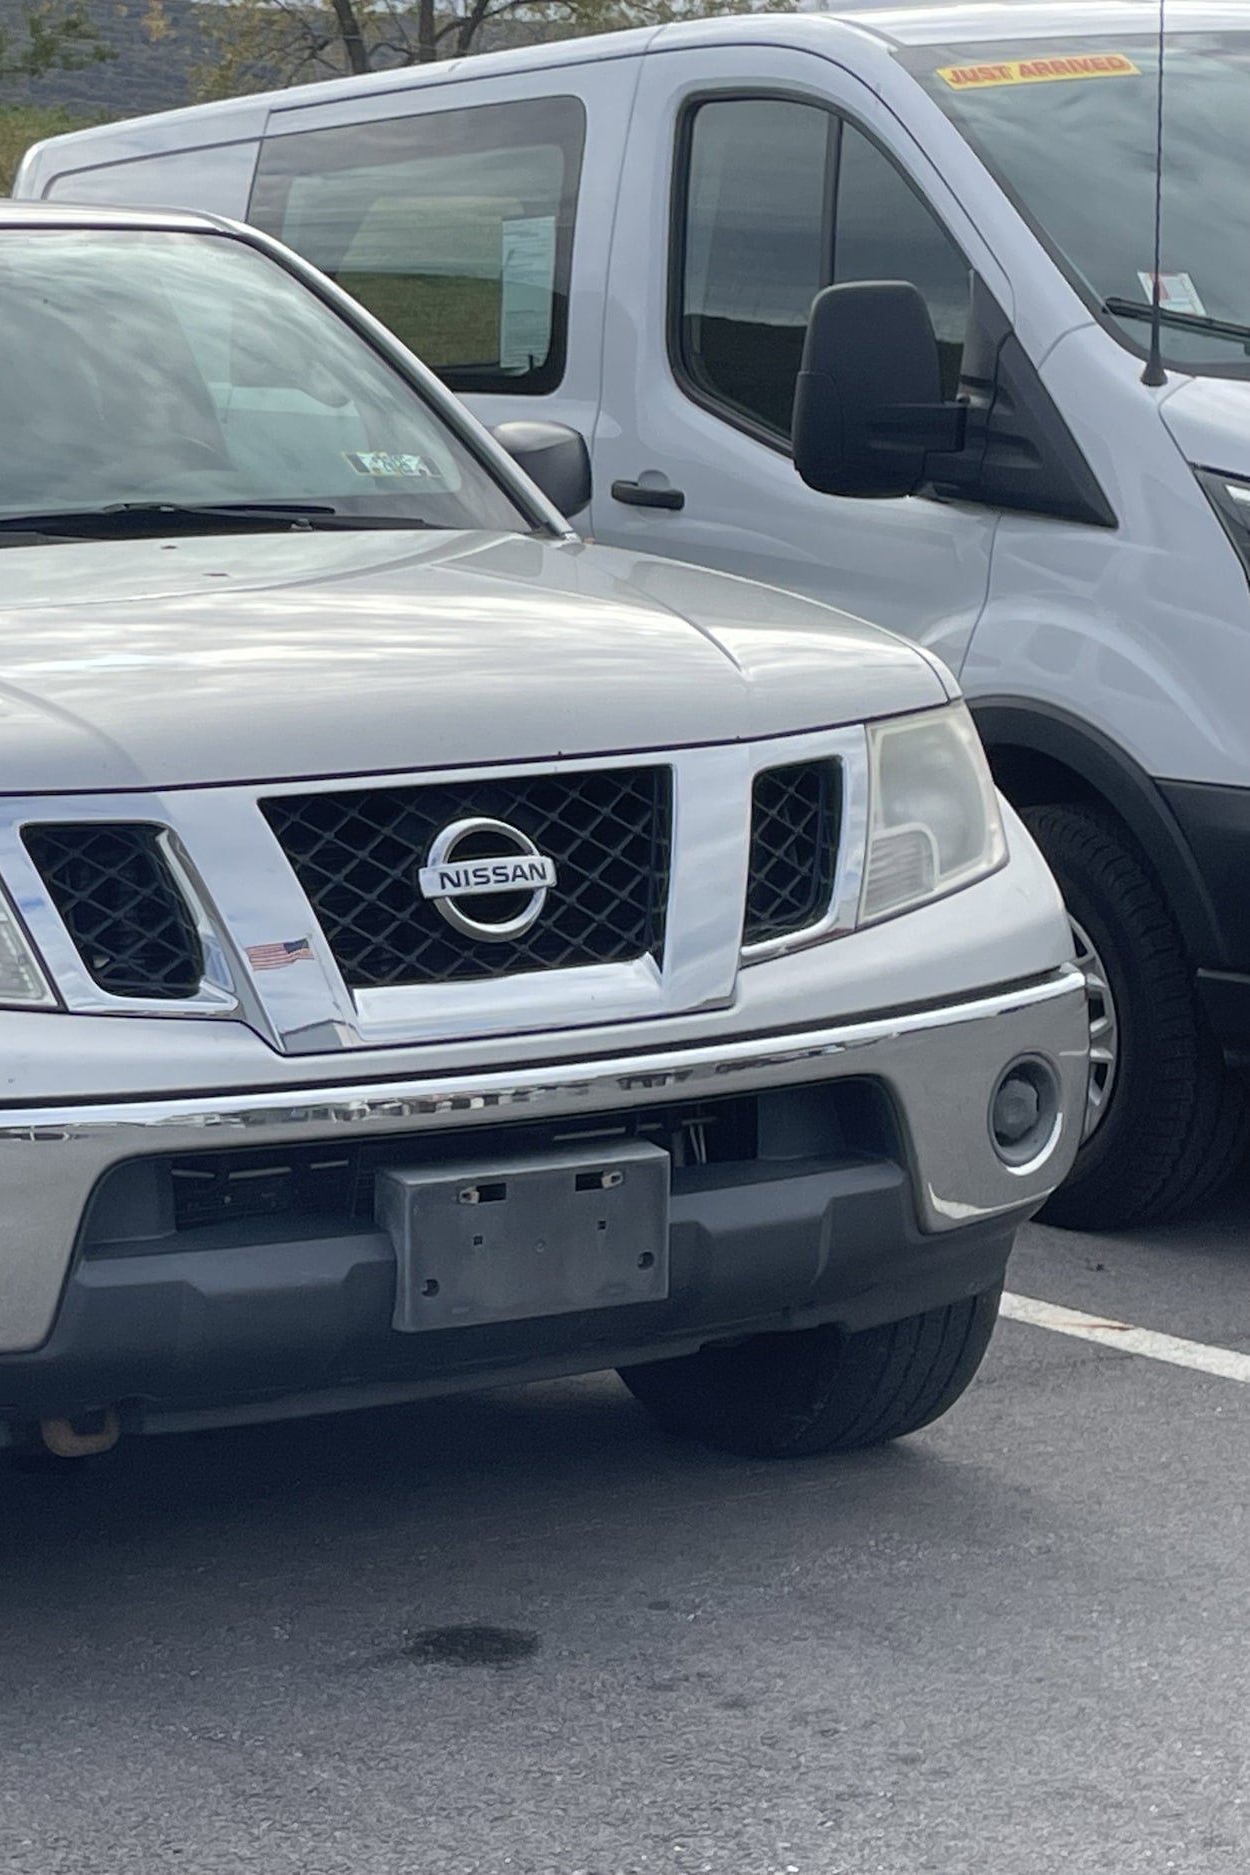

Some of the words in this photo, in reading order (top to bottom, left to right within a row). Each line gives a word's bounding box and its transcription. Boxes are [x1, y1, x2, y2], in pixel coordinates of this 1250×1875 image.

[949, 66, 1013, 84] JUST
[1020, 56, 1130, 78] ARRIVED
[438, 862, 547, 890] NISSAN
